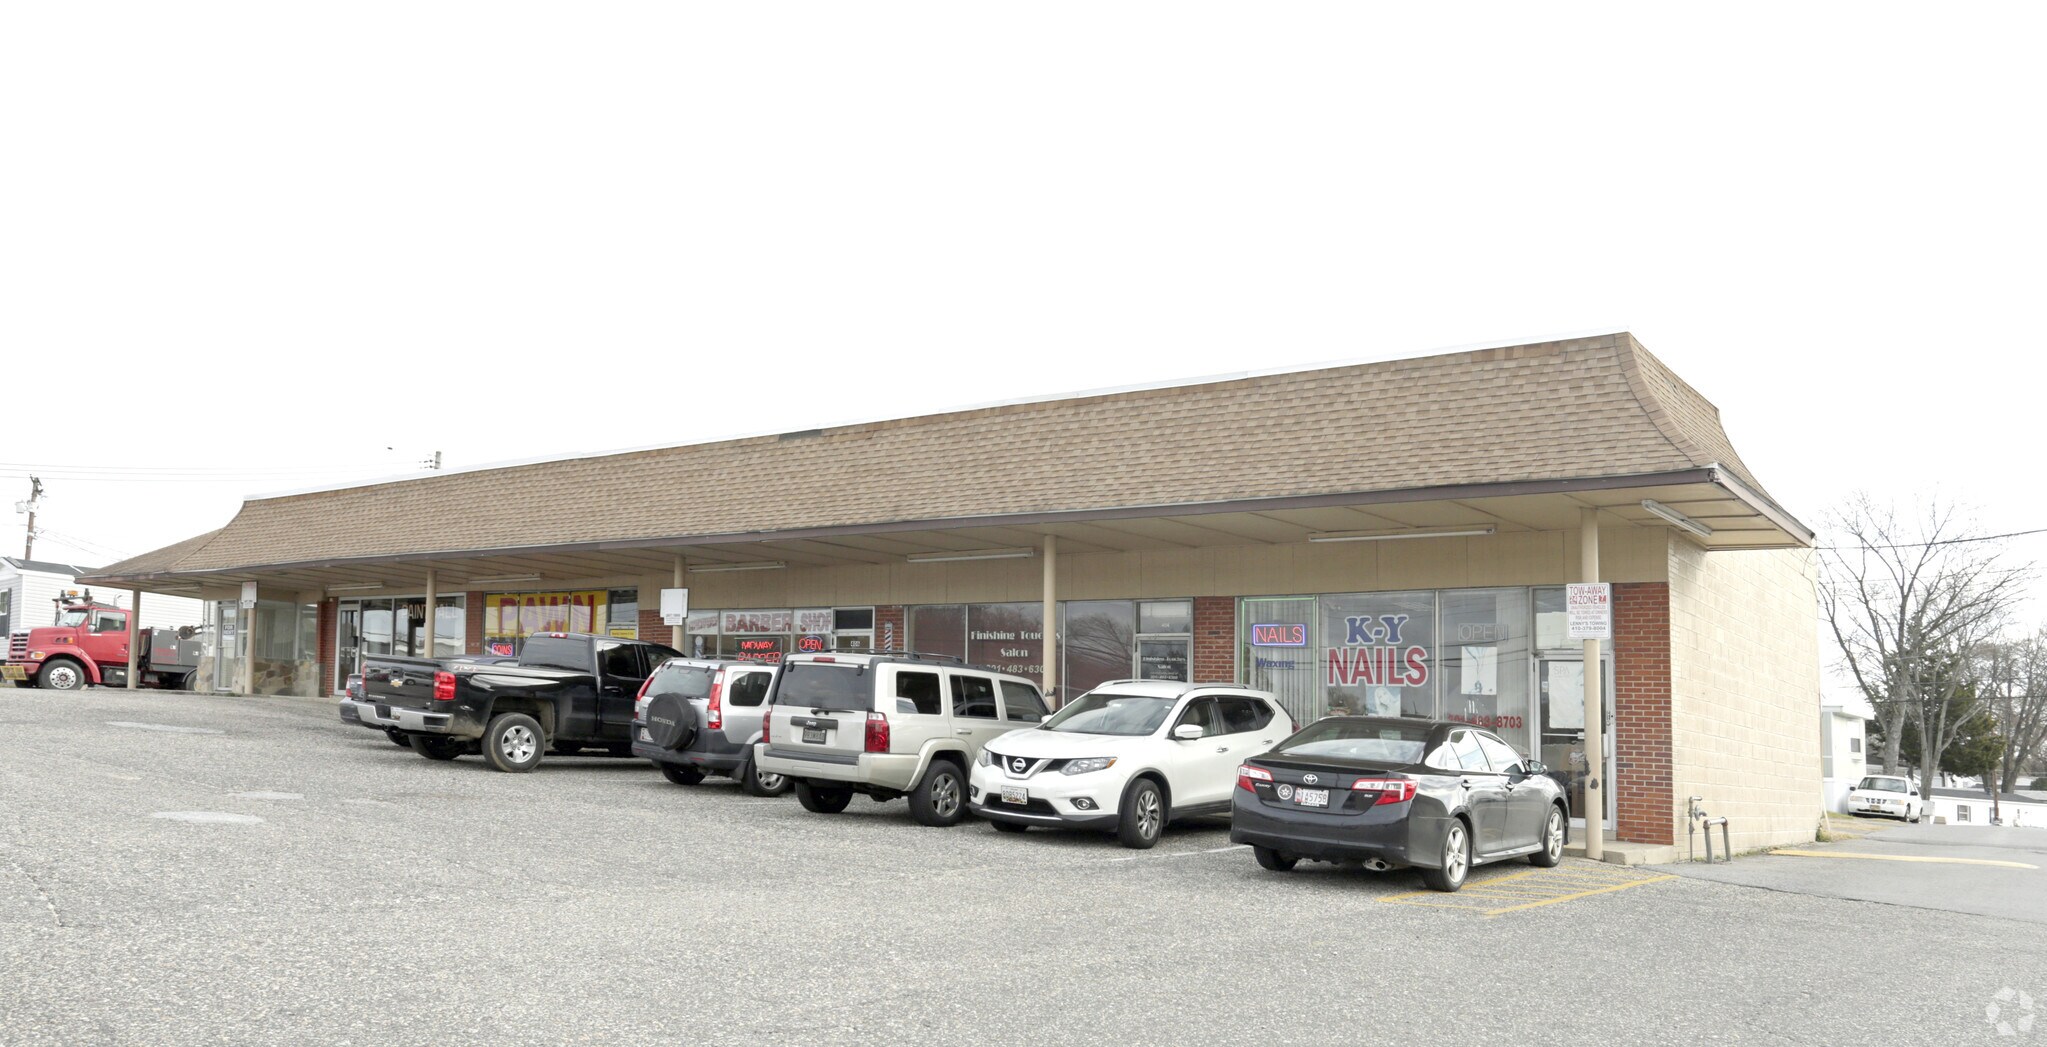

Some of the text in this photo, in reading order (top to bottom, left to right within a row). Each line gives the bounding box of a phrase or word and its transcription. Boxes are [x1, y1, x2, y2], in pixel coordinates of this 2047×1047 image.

[1569, 586, 1606, 595] TOW-AWAY
[1578, 595, 1598, 604] ZONE
[498, 594, 595, 634] PAWN
[725, 613, 792, 632] BARBER
[970, 631, 1061, 640] Finishing Toucs
[1255, 626, 1304, 643] NAILS
[1345, 614, 1409, 645] K-Y
[1460, 624, 1507, 640] OPEN
[741, 641, 774, 649] MIDWAY
[799, 638, 823, 650] OPEN
[1000, 647, 1028, 657] Salon
[1255, 656, 1295, 669] Waxing
[1327, 645, 1429, 687] NAILS
[1553, 666, 1569, 675] SPA
[651, 716, 675, 726] HONDA
